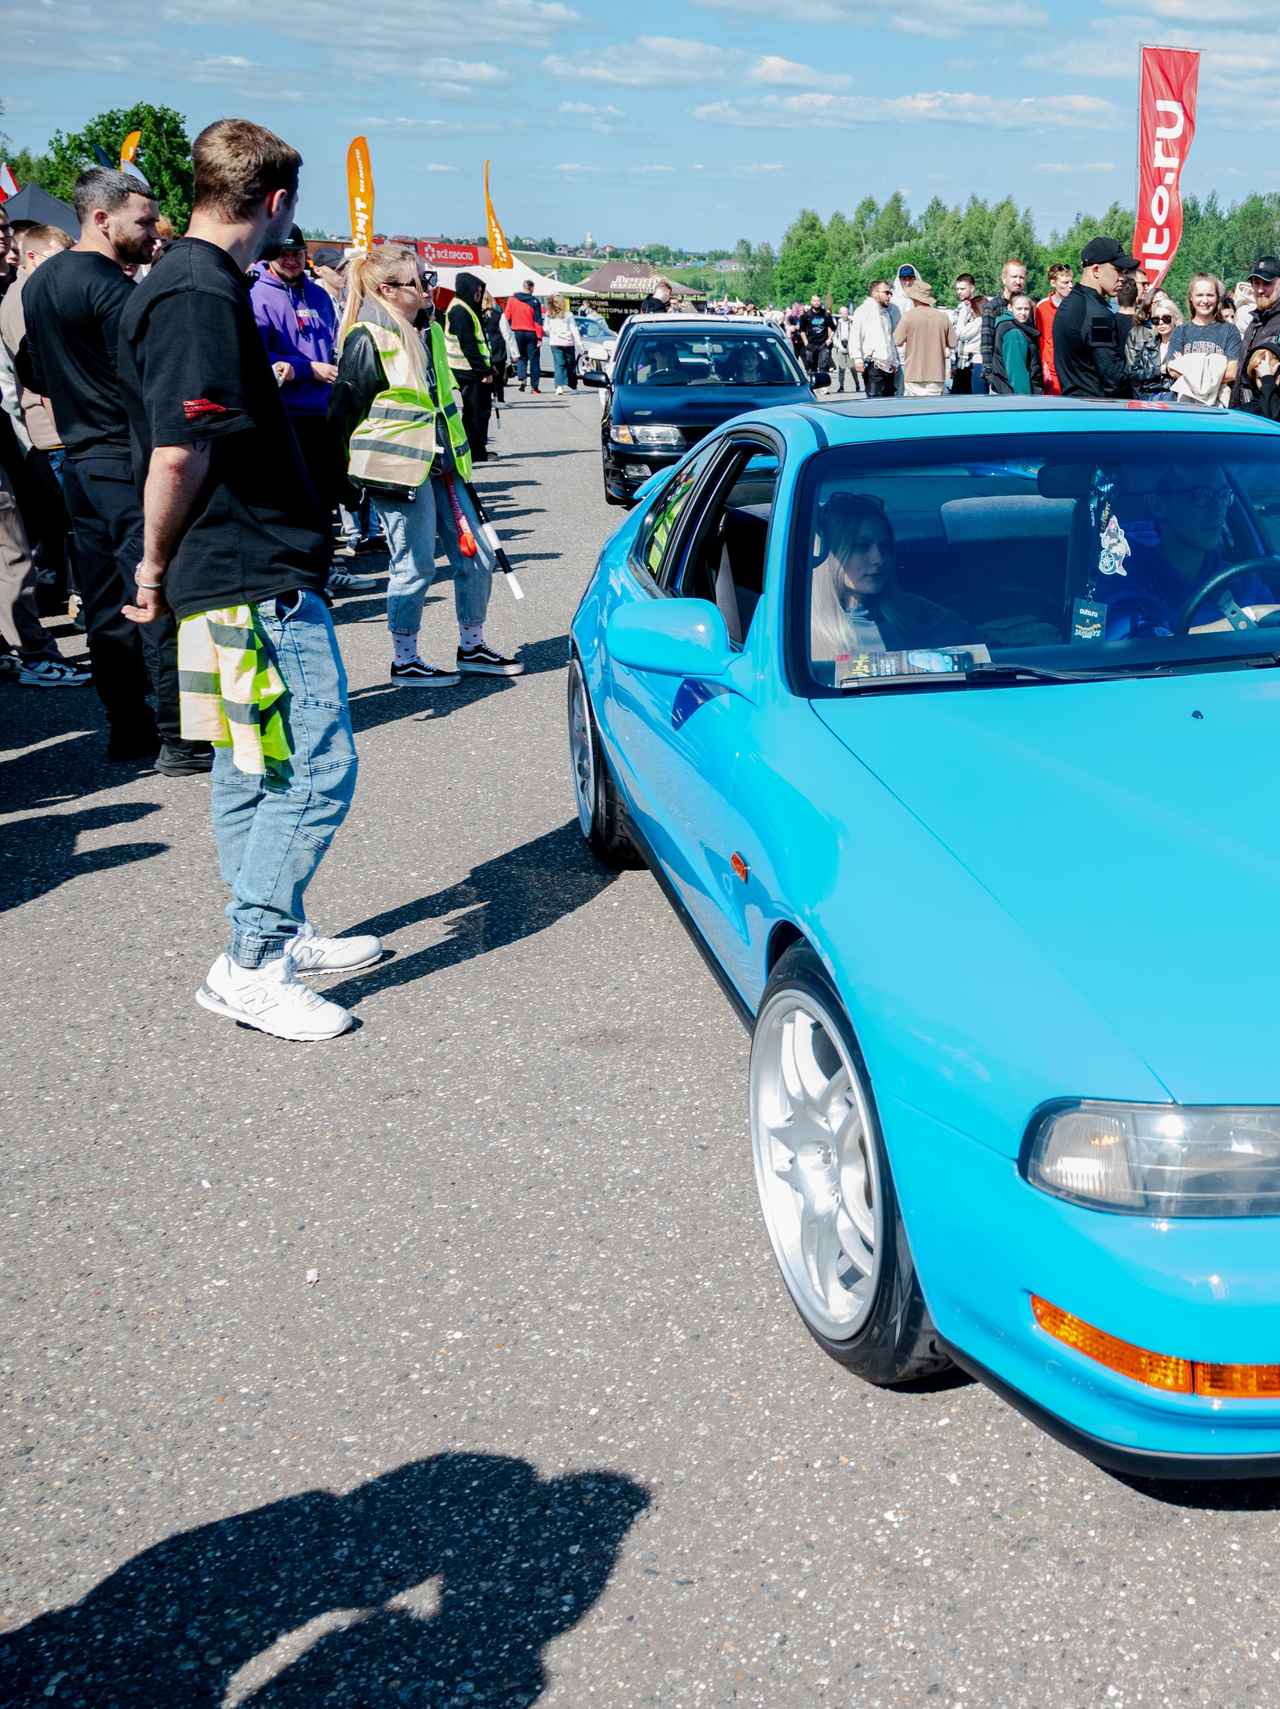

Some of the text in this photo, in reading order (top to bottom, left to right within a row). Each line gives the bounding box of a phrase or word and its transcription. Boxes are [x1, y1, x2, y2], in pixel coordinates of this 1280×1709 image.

[1142, 99, 1184, 290] uto.ru
[436, 249, 474, 261] ВСЁ ПРОСТО
